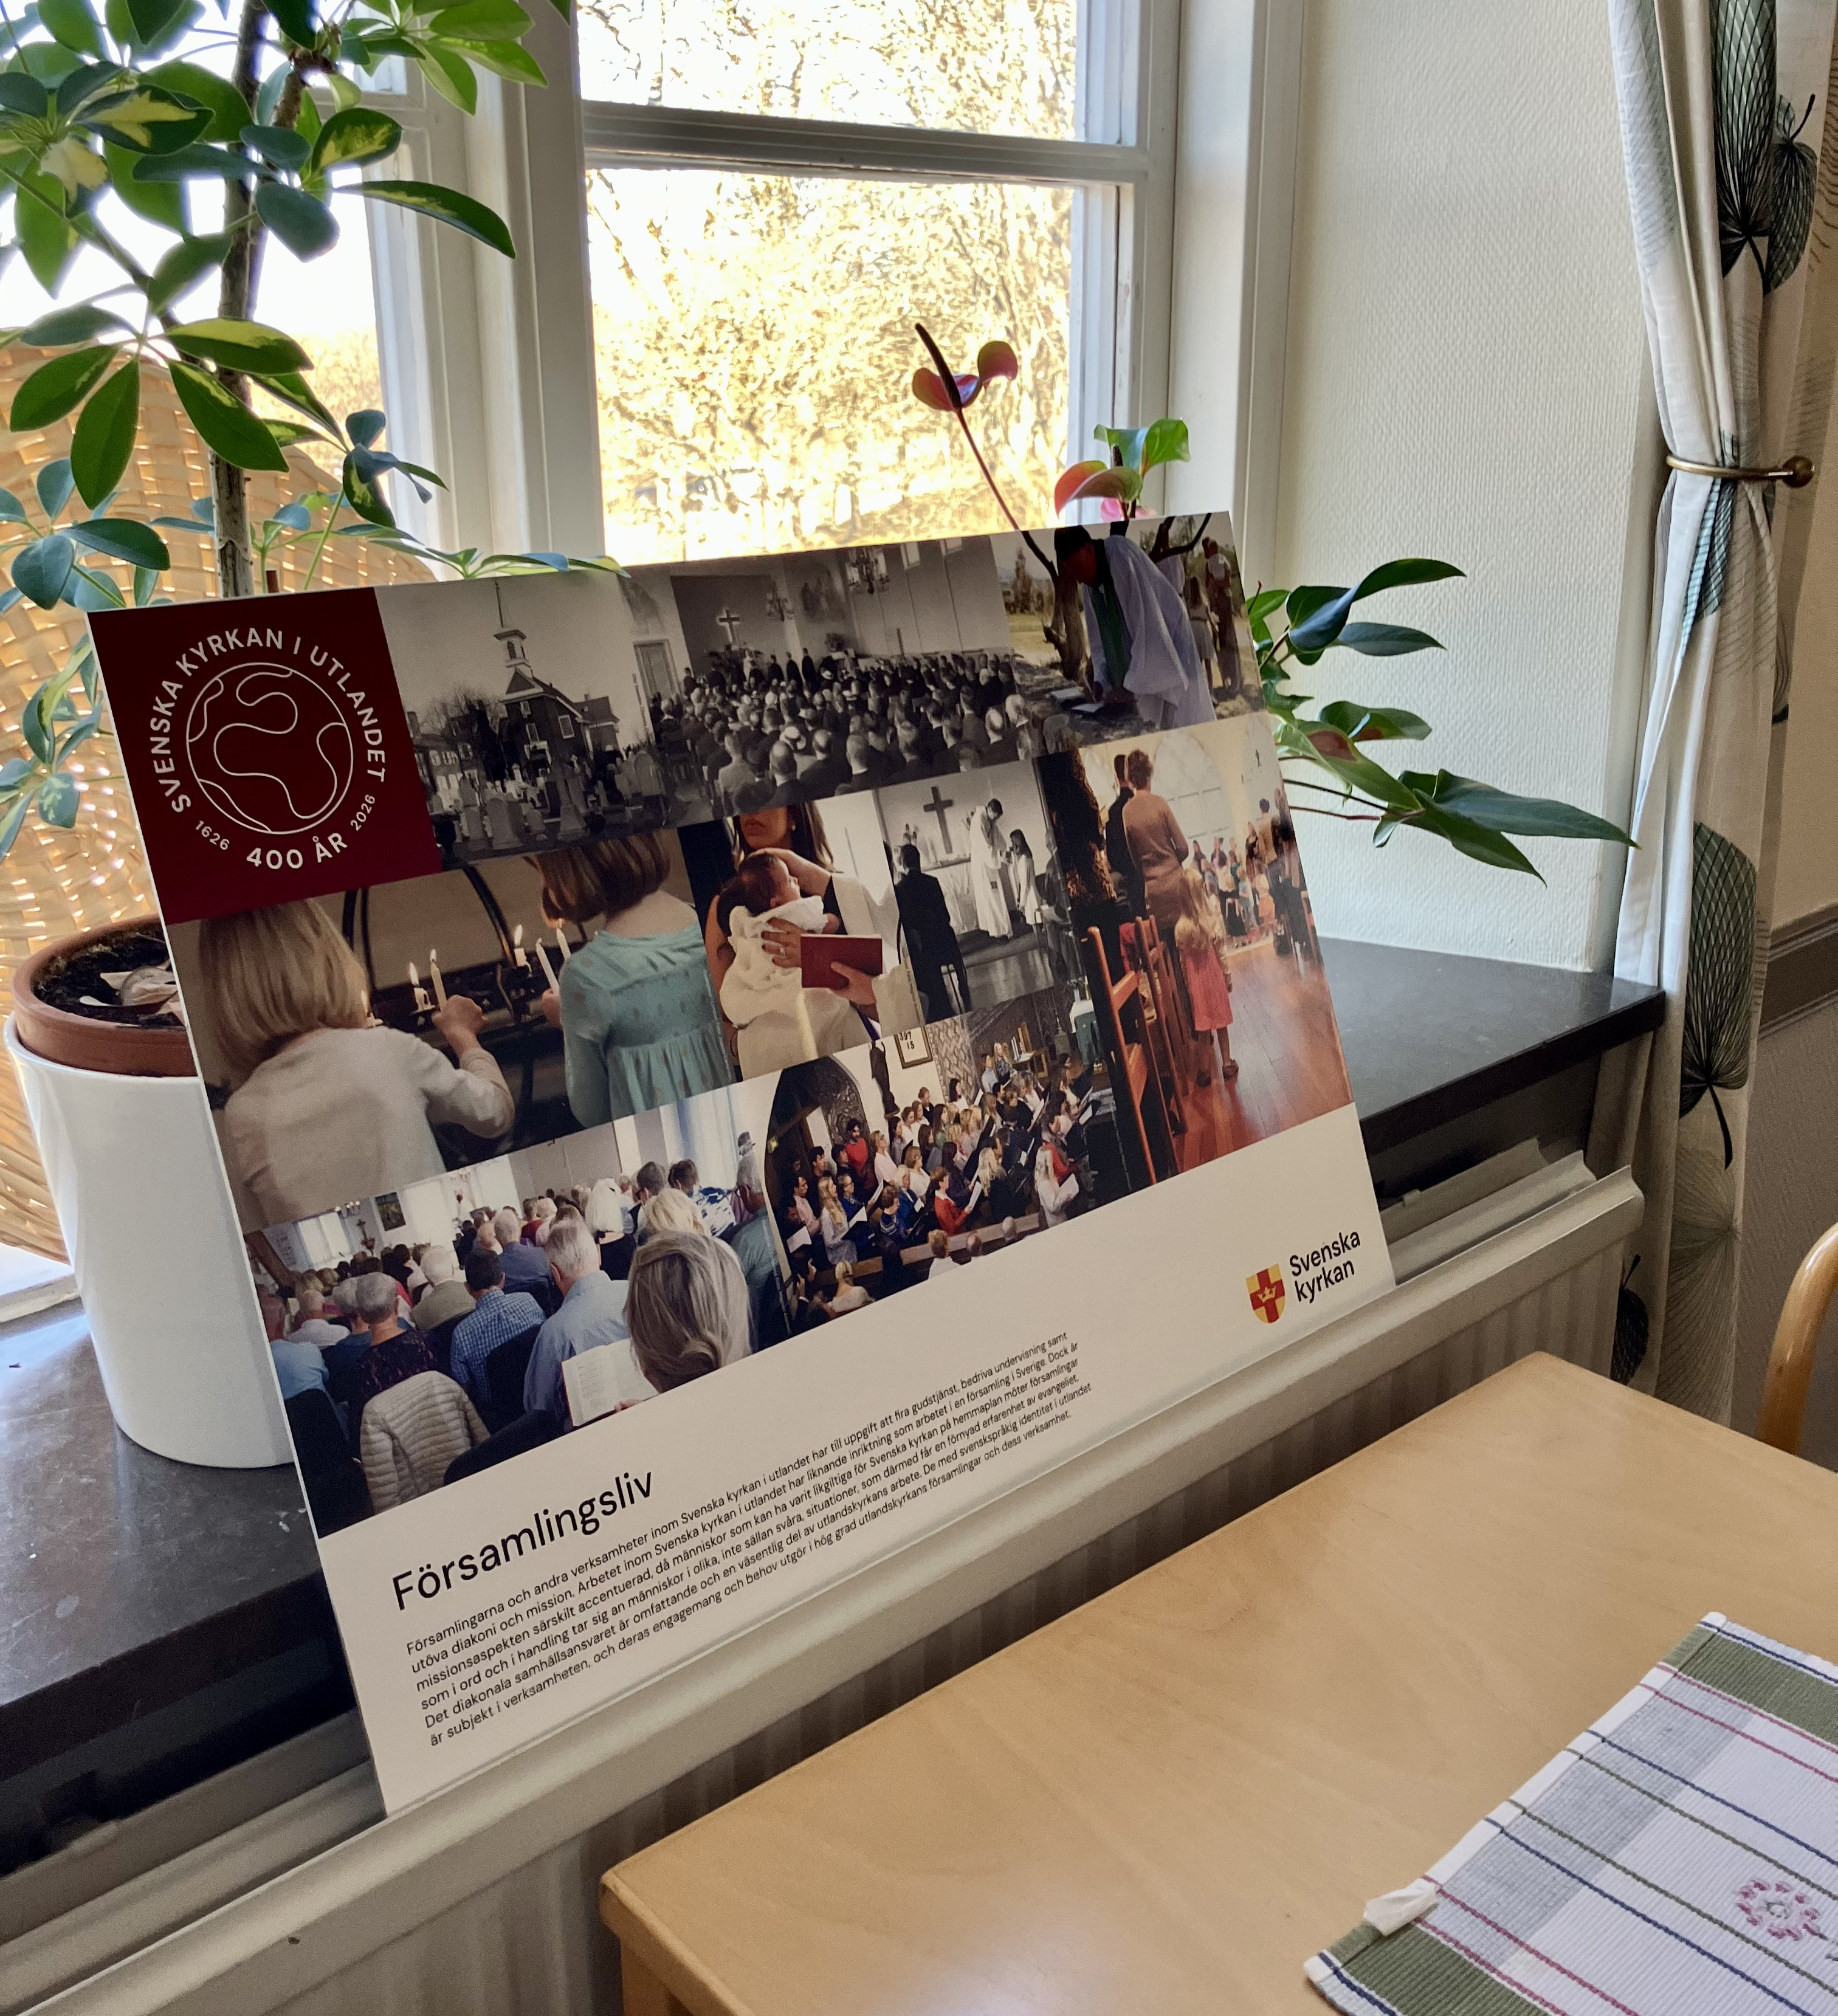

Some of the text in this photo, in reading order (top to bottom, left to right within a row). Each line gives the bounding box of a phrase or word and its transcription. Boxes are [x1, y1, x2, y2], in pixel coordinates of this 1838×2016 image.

[149, 627, 386, 813] SVENSKA KYRKAN I UTLANDET
[350, 794, 376, 831] 2026
[195, 820, 230, 851] 1626
[246, 831, 348, 870] 400 ÅR
[1289, 1231, 1361, 1277] Svenska
[1294, 1260, 1355, 1304] kyrkan
[392, 1471, 652, 1611] Församlingsliv
[406, 1603, 505, 1656] Församlingarna
[508, 1589, 531, 1608] och
[534, 1572, 569, 1595] andra
[570, 1533, 649, 1577] verksamheter
[650, 1519, 680, 1540] inom
[681, 1497, 725, 1524] Svenska
[726, 1479, 762, 1503] kyrkan
[762, 1474, 767, 1485] i
[768, 1455, 810, 1482] utlandet
[811, 1447, 828, 1462] har
[830, 1437, 842, 1453] till
[844, 1422, 878, 1446] uppgift
[879, 1414, 893, 1428] att
[894, 1408, 910, 1422] fira
[960, 1368, 993, 1389] bedriva
[994, 1342, 1047, 1374] undervisning
[1047, 1332, 1068, 1348] samt
[411, 1650, 449, 1673] utöva
[452, 1623, 497, 1654] diakoni
[500, 1612, 524, 1631] och
[526, 1589, 575, 1619] mission.
[578, 1564, 622, 1594] Arbetet
[623, 1550, 653, 1572] inom
[655, 1528, 700, 1556] Svenska
[701, 1510, 737, 1533] kyrkan
[738, 1504, 743, 1515] i
[744, 1484, 787, 1512] utlandet
[788, 1475, 805, 1491] har
[807, 1455, 847, 1481] liknande
[848, 1433, 893, 1460] inriktning
[893, 1423, 914, 1439] som
[915, 1405, 948, 1428] arbetet
[948, 1400, 953, 1412] i
[954, 1397, 966, 1409] en
[966, 1375, 1011, 1403] församling
[1010, 1371, 1015, 1381] i
[1047, 1346, 1069, 1363] Dock
[1070, 1342, 1078, 1353] är
[416, 1358, 1078, 1693] missionsaspekten särskilt accentuerad, då människor som kan ha varit likgiltiga för Svenska kyrkan på hemmaplan möter församlingar
[421, 1690, 450, 1710] som
[451, 1682, 456, 1695] i
[460, 1670, 482, 1691] ord
[484, 1659, 509, 1679] och
[510, 1653, 516, 1666] i
[517, 1629, 570, 1663] handling
[571, 1620, 588, 1635] tar
[591, 1610, 609, 1626] sig
[611, 1603, 625, 1616] an
[627, 1572, 684, 1608] människor
[686, 1566, 691, 1578] i
[721, 1544, 742, 1561] inte
[744, 1528, 774, 1549] sällan
[861, 1473, 882, 1490] som
[883, 1451, 919, 1479] därmed
[920, 1446, 932, 1460] får
[934, 1441, 946, 1453] en
[947, 1420, 981, 1447] förnyad
[982, 1400, 1025, 1428] erfarenhet
[1027, 1395, 1036, 1406] av
[424, 1708, 450, 1729] Det
[452, 1679, 512, 1715] diakonala
[514, 1625, 616, 1684] samhällsansvaret
[619, 1618, 630, 1631] är
[633, 1584, 698, 1624] omfattande
[700, 1572, 721, 1589] och
[723, 1565, 737, 1578] en
[738, 1540, 784, 1569] väsentlig
[785, 1528, 802, 1546] del
[804, 1524, 814, 1536] av
[816, 1487, 889, 1530] utlandskyrkans
[923, 1462, 936, 1475] De
[937, 1449, 958, 1468] med
[959, 1421, 1018, 1457] svenskspråkig
[1018, 1402, 1054, 1427] identitet
[1053, 1398, 1058, 1408] i
[1058, 1383, 1092, 1406] utlandet
[430, 1410, 1072, 1747] är subjekt i verksamheten, och deras engagemang och behov utgör i hög grad utlandskyrkans församlingar och dess verksamhet.
